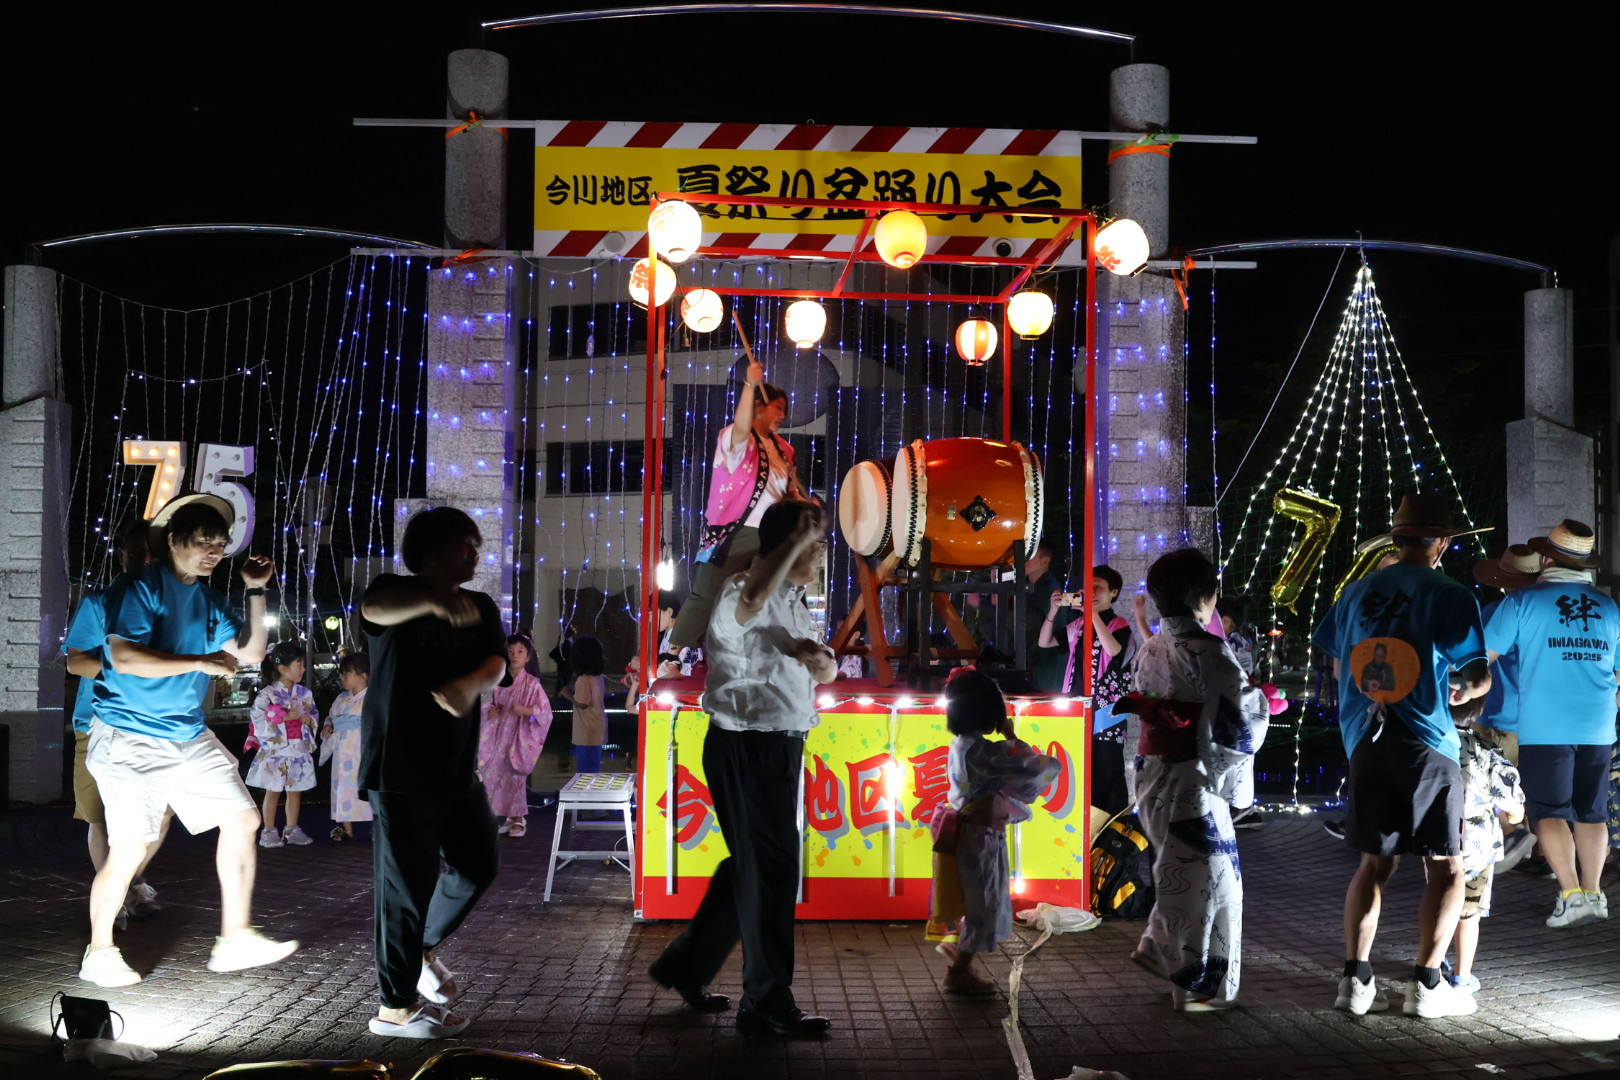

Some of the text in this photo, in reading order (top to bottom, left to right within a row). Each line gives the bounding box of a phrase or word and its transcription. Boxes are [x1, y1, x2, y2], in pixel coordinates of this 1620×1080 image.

[545, 174, 653, 206] 今川地区
[677, 164, 1061, 224] 夏祭り盆踊り大会
[123, 440, 256, 558] 75
[1555, 593, 1602, 632] 絆
[1548, 636, 1609, 651] IMAGAWA
[1562, 652, 1602, 662] 2025
